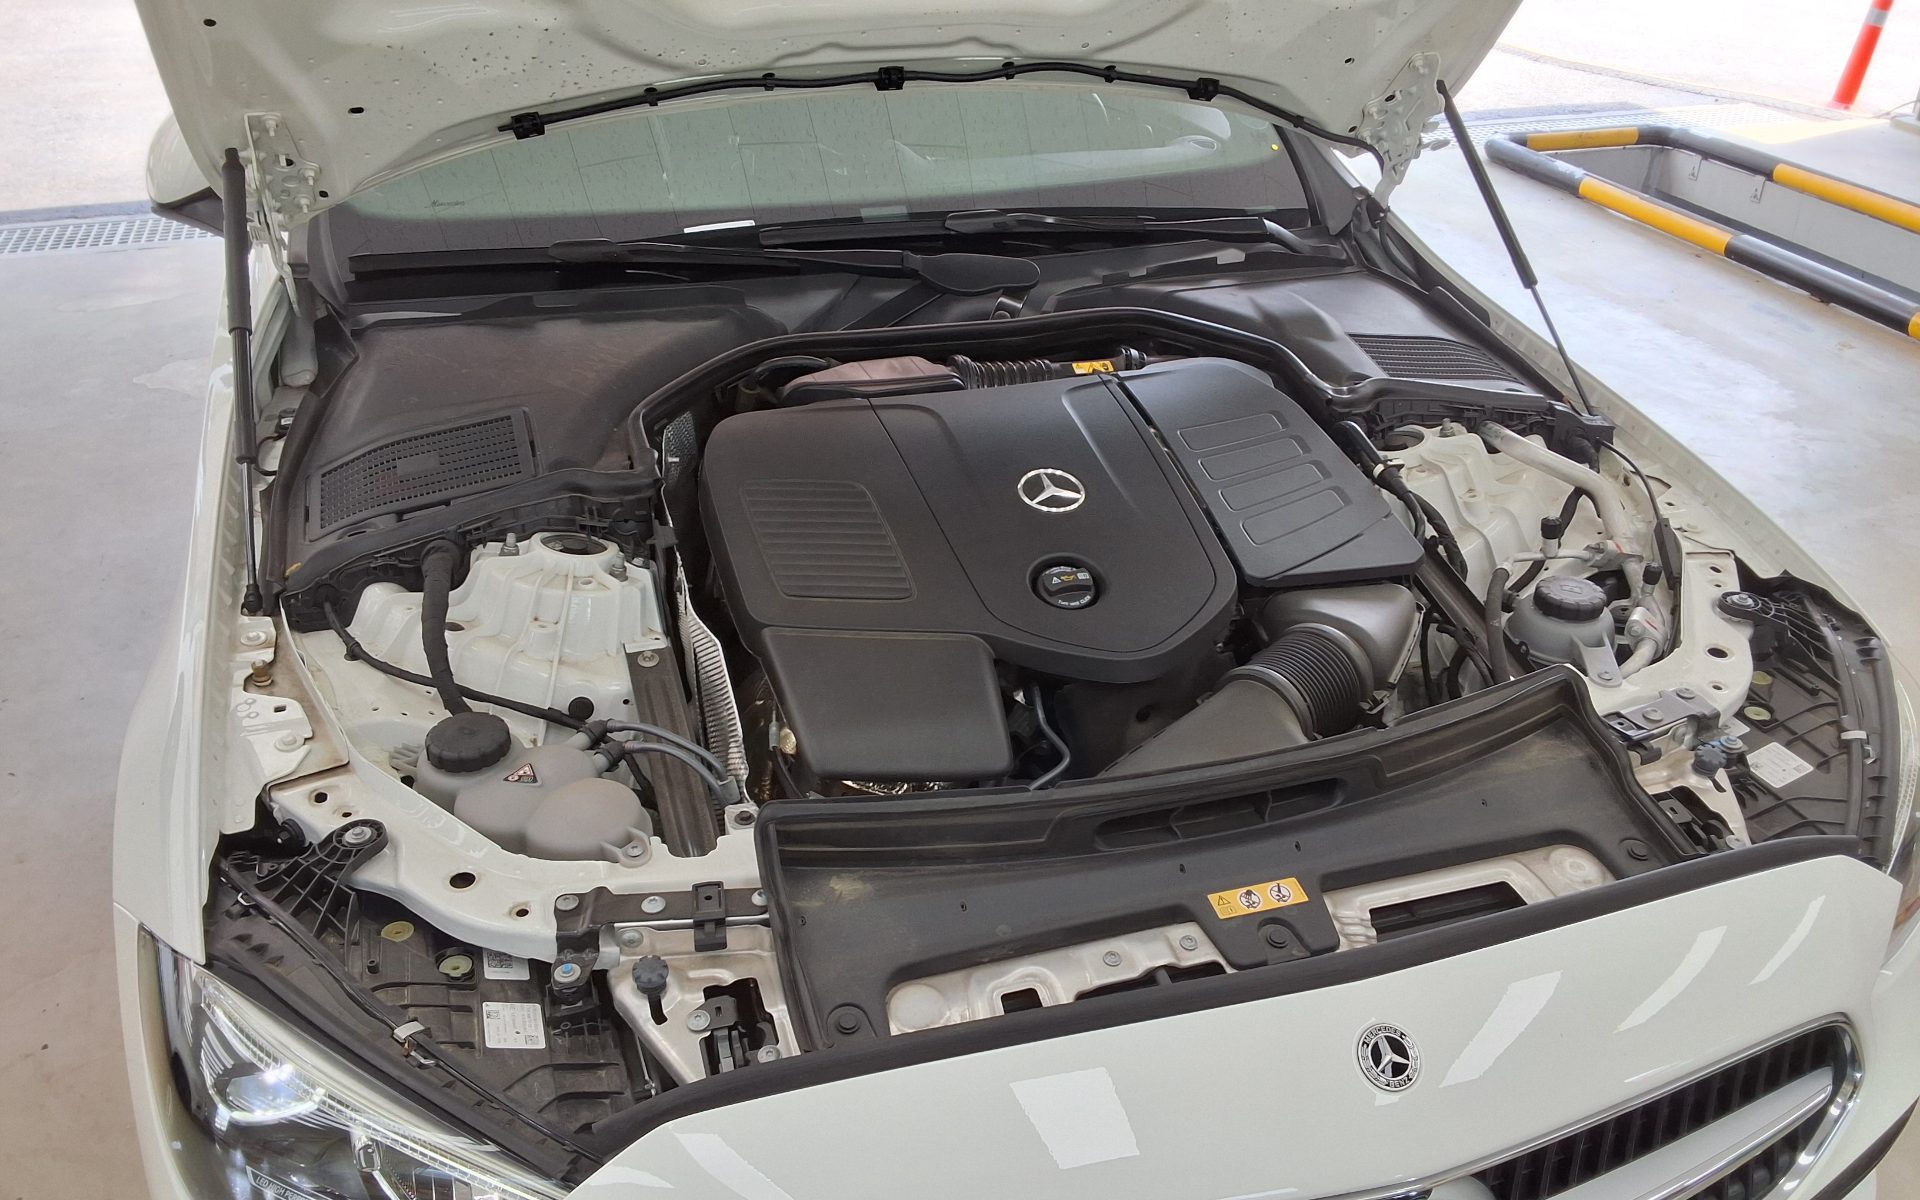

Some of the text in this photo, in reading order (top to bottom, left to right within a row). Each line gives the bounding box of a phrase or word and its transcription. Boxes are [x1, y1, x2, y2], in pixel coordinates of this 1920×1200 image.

[1364, 1026, 1401, 1044] MERCEDES
[1389, 1076, 1410, 1088] BENZ
[256, 1176, 269, 1187] LED
[268, 1182, 286, 1195] HIGH
